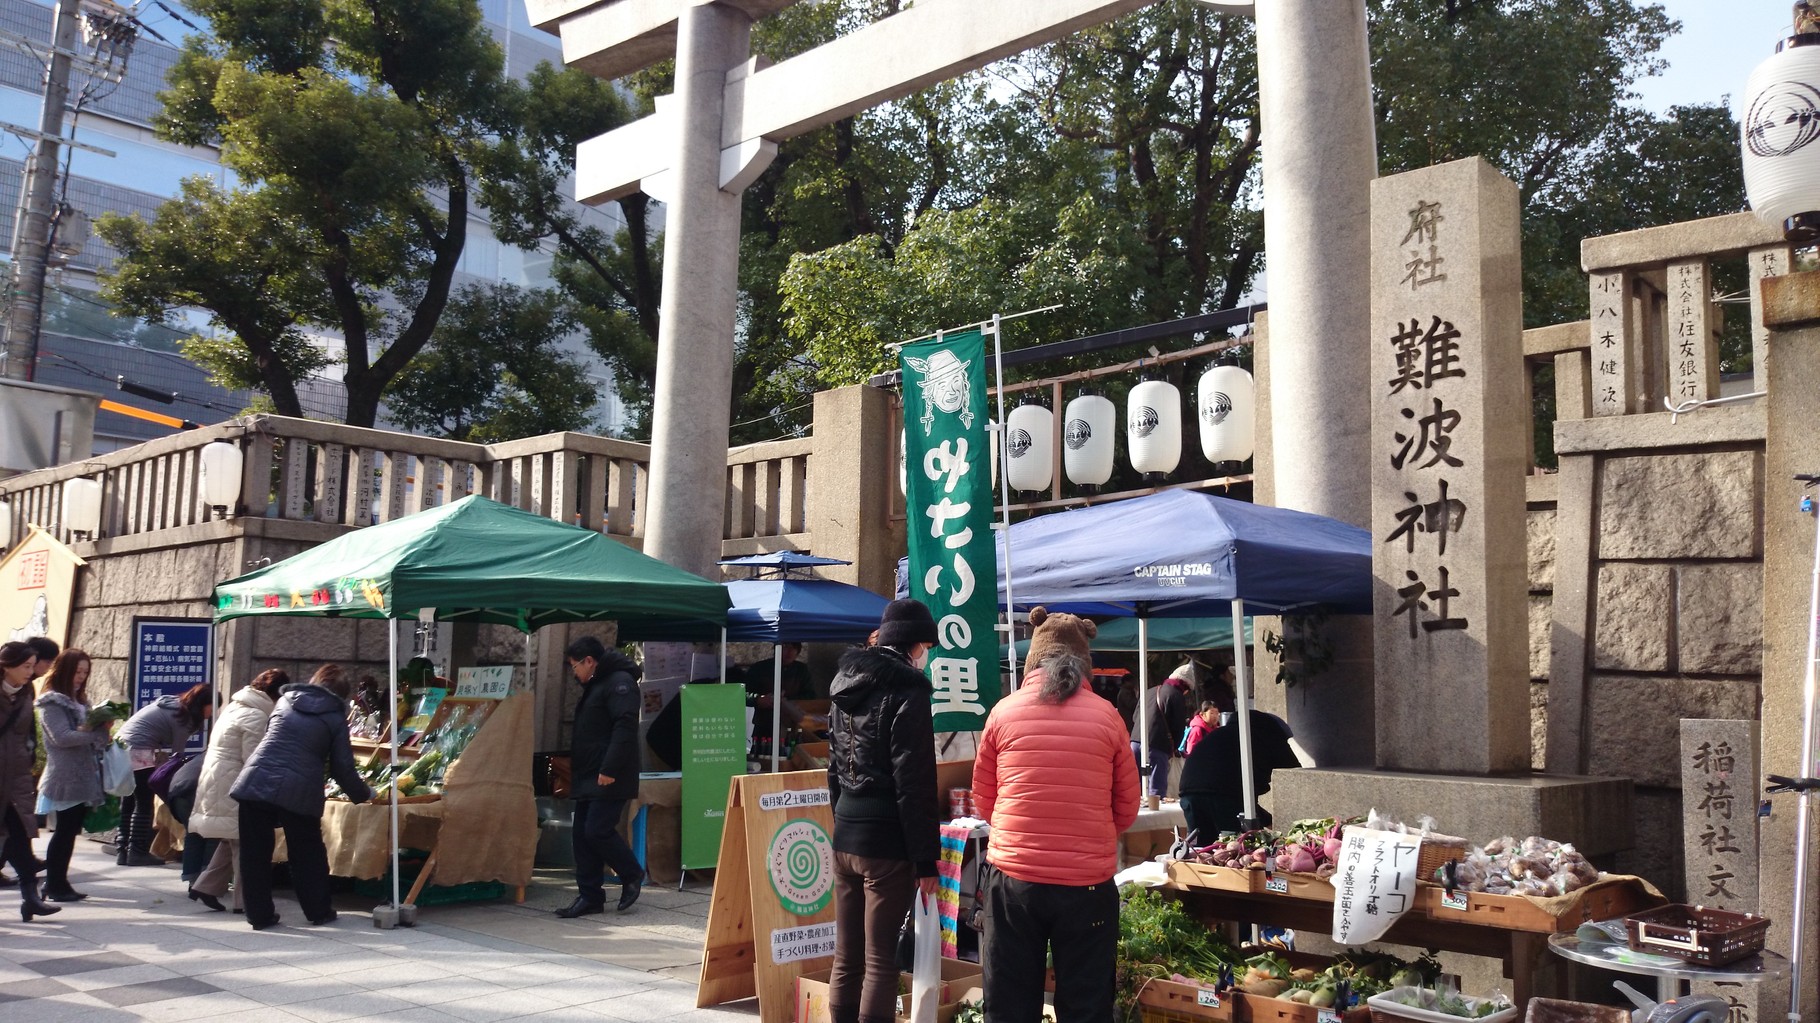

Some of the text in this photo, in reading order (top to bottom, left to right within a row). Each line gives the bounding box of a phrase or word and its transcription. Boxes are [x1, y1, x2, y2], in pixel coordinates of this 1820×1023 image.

[1598, 278, 1618, 403] 小八木健次
[1678, 266, 1698, 397] 株式会社住友銀行
[1384, 315, 1469, 639] 難波神社
[1134, 563, 1212, 578] CAPTAIN STAG
[761, 792, 829, 807] 毎月第2土曜日開催
[1386, 841, 1417, 914] ヤーコ
